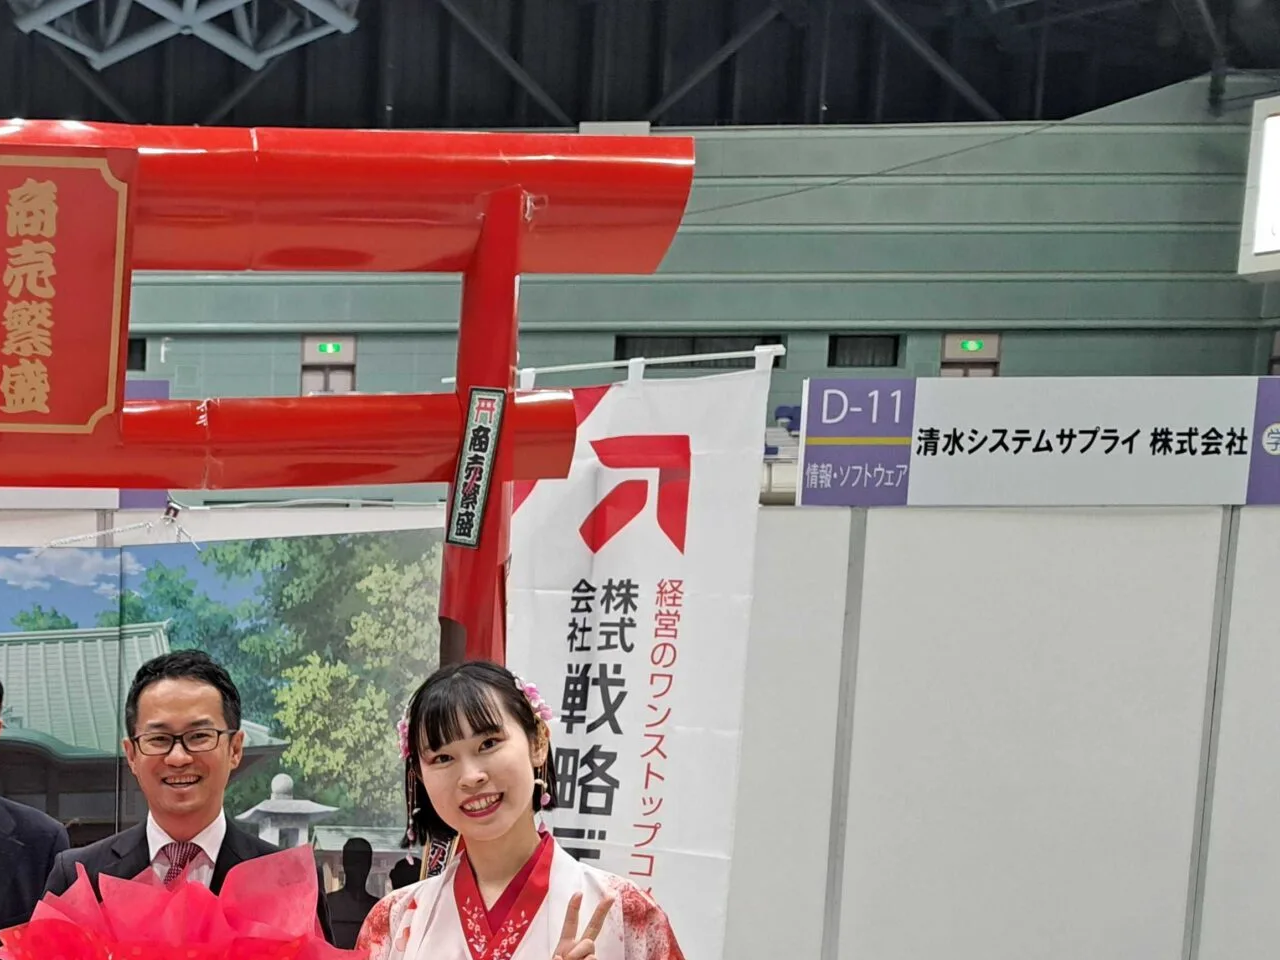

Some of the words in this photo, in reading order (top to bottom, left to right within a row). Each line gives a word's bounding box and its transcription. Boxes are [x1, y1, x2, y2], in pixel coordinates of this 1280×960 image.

[0, 177, 59, 414] 商売繁盛
[822, 388, 903, 424] D-11
[916, 426, 1142, 457] 清水システムサプライ
[1149, 426, 1249, 457] 株式会社
[628, 578, 684, 898] 経営のワンストップコ
